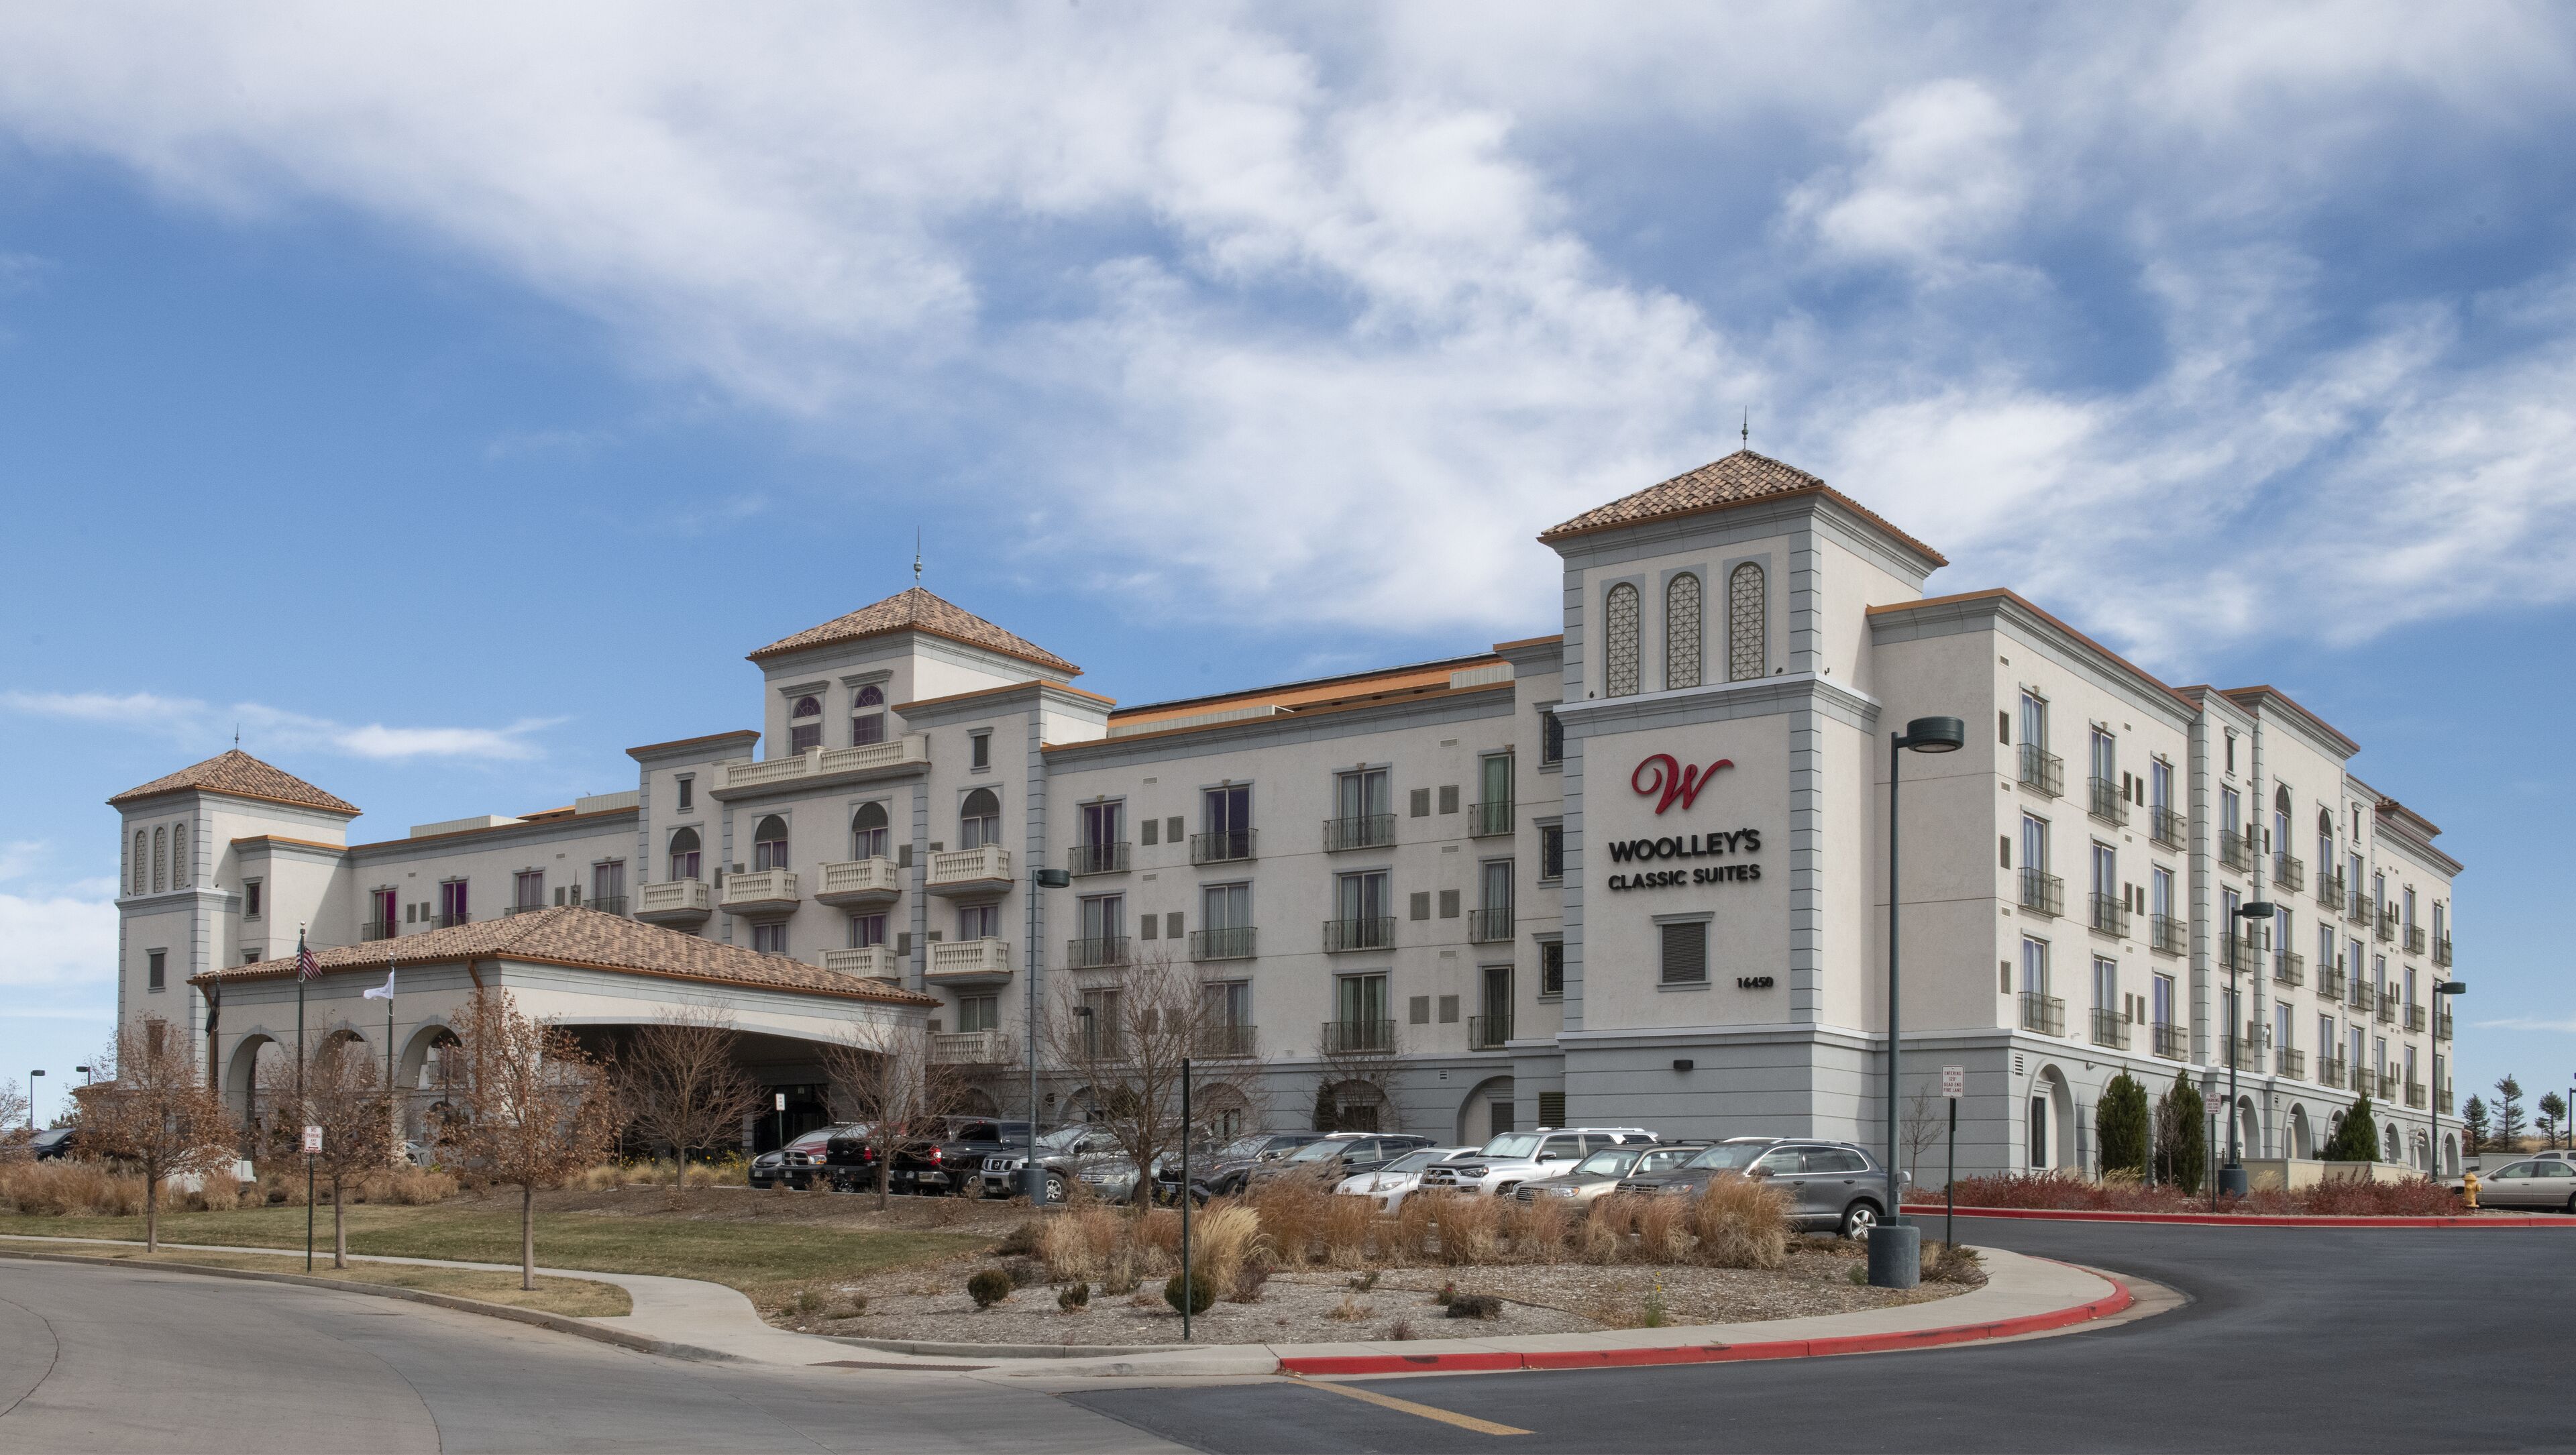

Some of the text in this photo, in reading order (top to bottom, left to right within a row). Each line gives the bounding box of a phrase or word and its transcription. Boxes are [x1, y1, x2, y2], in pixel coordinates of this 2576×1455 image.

[1608, 828, 1761, 863] WOOLLEY'S
[1608, 863, 1761, 892] CLASSIC SUITES
[1736, 976, 1774, 988] 16450
